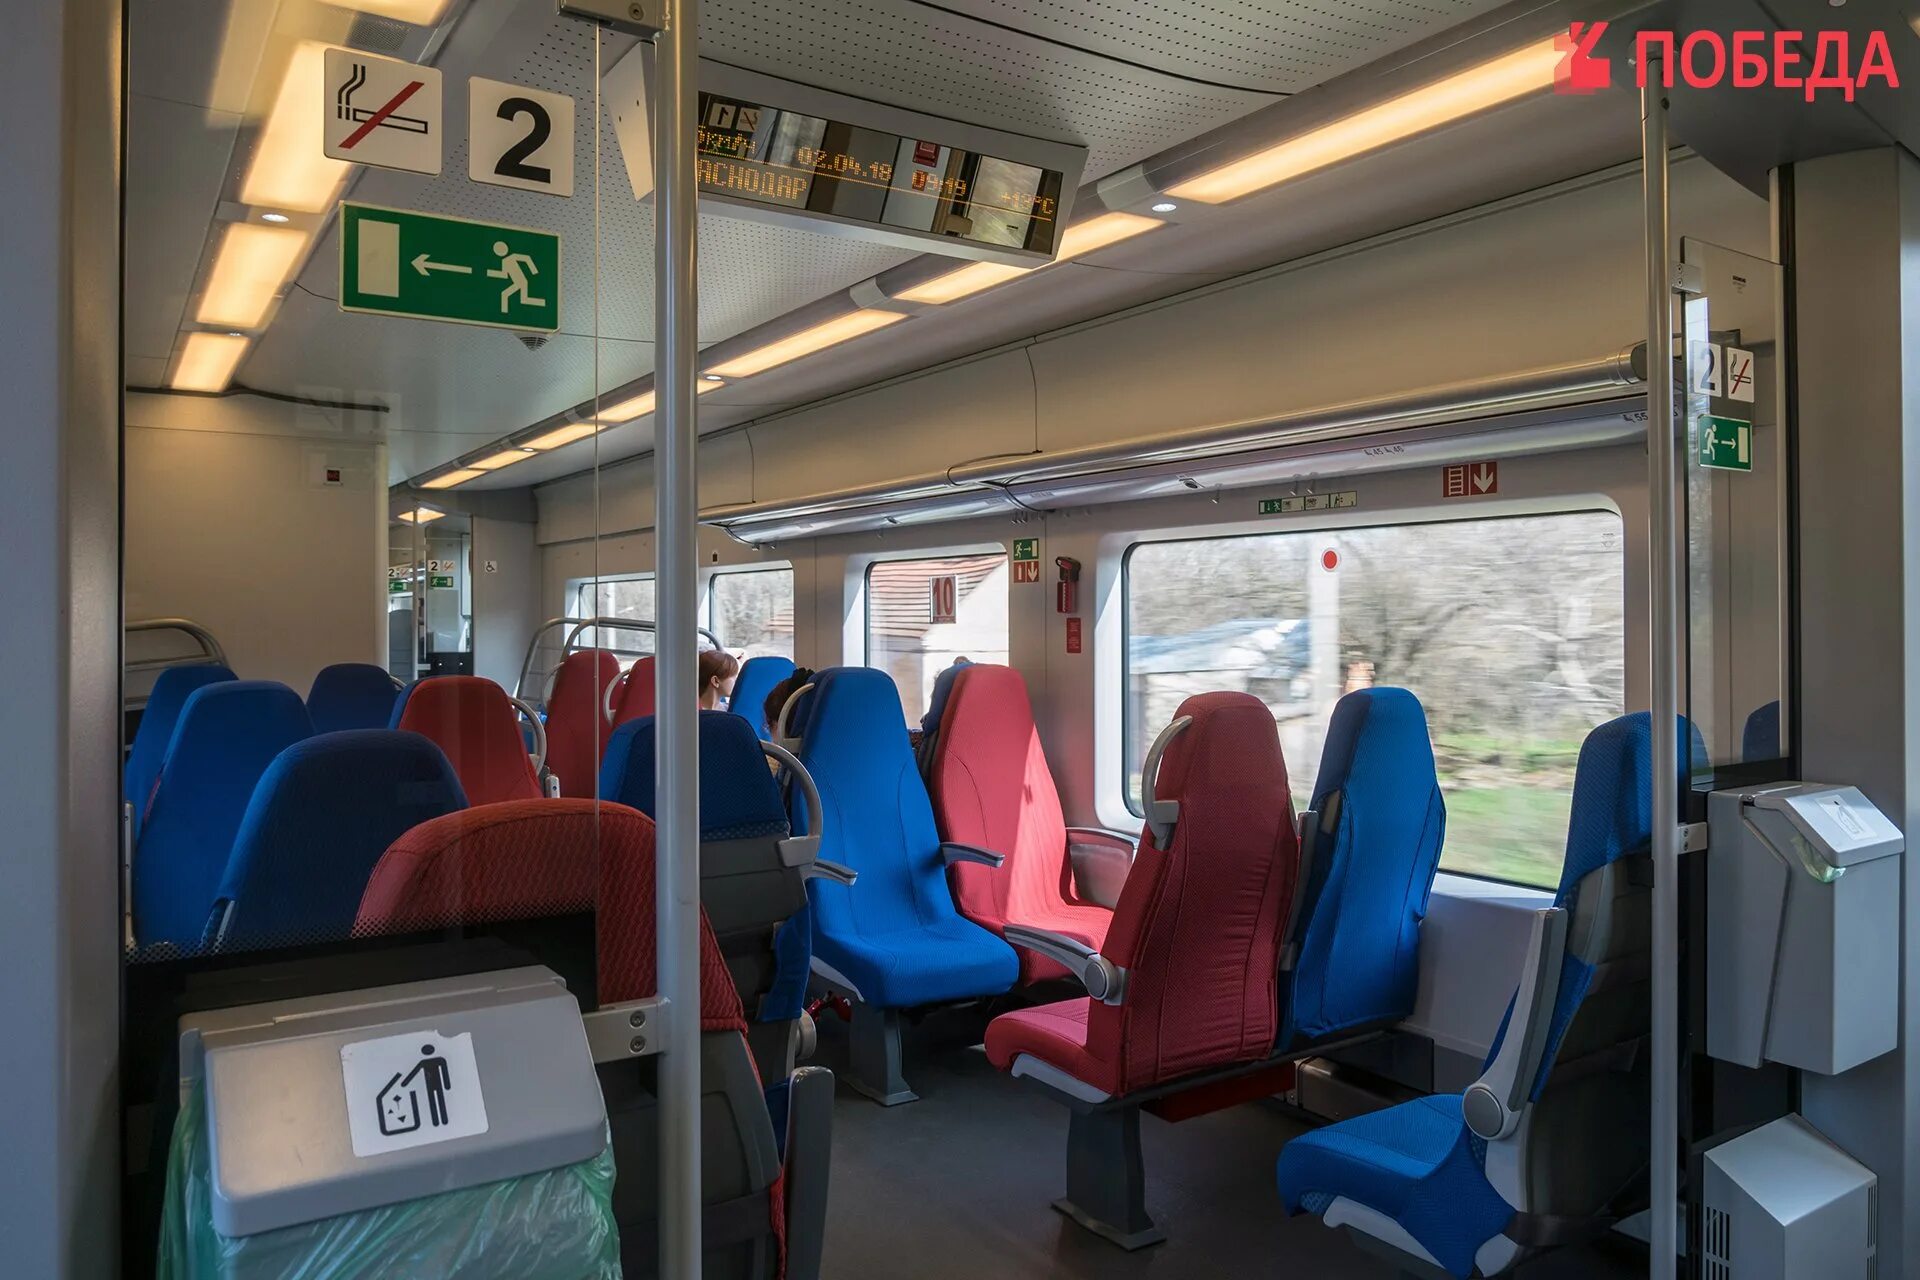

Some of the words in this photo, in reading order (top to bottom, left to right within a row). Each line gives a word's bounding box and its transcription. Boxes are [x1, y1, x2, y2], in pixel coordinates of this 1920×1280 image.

[494, 97, 551, 184] 2
[798, 146, 893, 182] 02.04.18
[1700, 348, 1715, 391] 2
[430, 561, 438, 571] 2
[933, 576, 954, 616] 10
